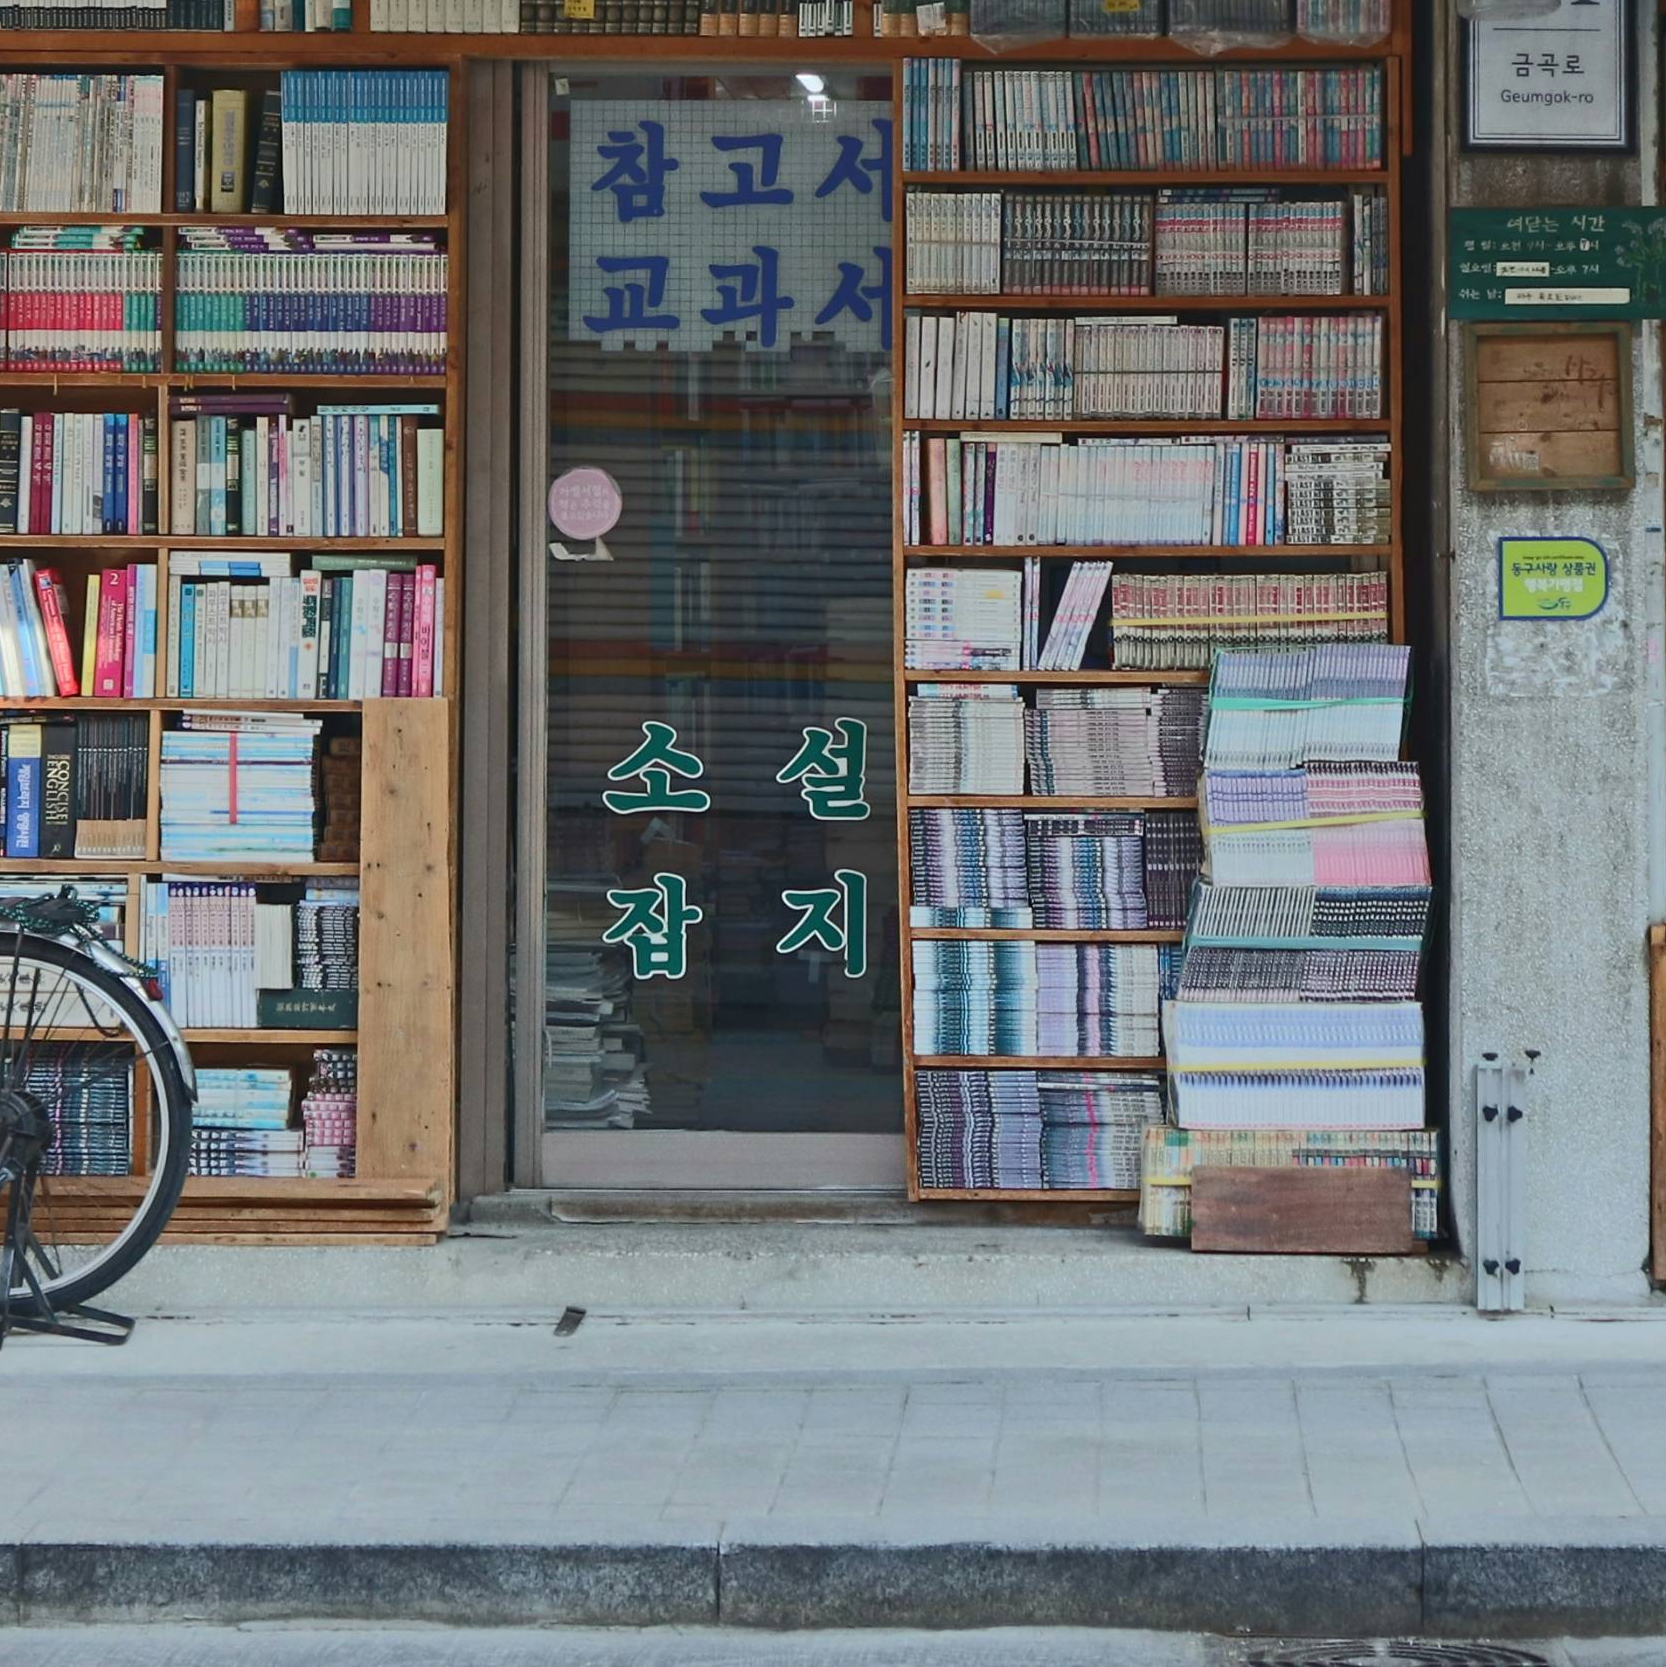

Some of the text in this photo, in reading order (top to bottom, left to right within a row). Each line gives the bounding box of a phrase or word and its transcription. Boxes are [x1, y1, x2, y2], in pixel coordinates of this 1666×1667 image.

[1511, 53, 1585, 78] 금곡로
[1500, 89, 1594, 107] Geumgok-ro
[589, 119, 893, 223] 참고서
[1570, 214, 1606, 233] 시간
[582, 245, 893, 351] 교과서
[109, 572, 119, 585] 2
[1512, 562, 1596, 576] 동구사랑 상품권
[44, 759, 58, 822] ENGLISH
[57, 759, 70, 824] CONCISE
[601, 716, 871, 821] 소설
[601, 867, 868, 981] 잡지
